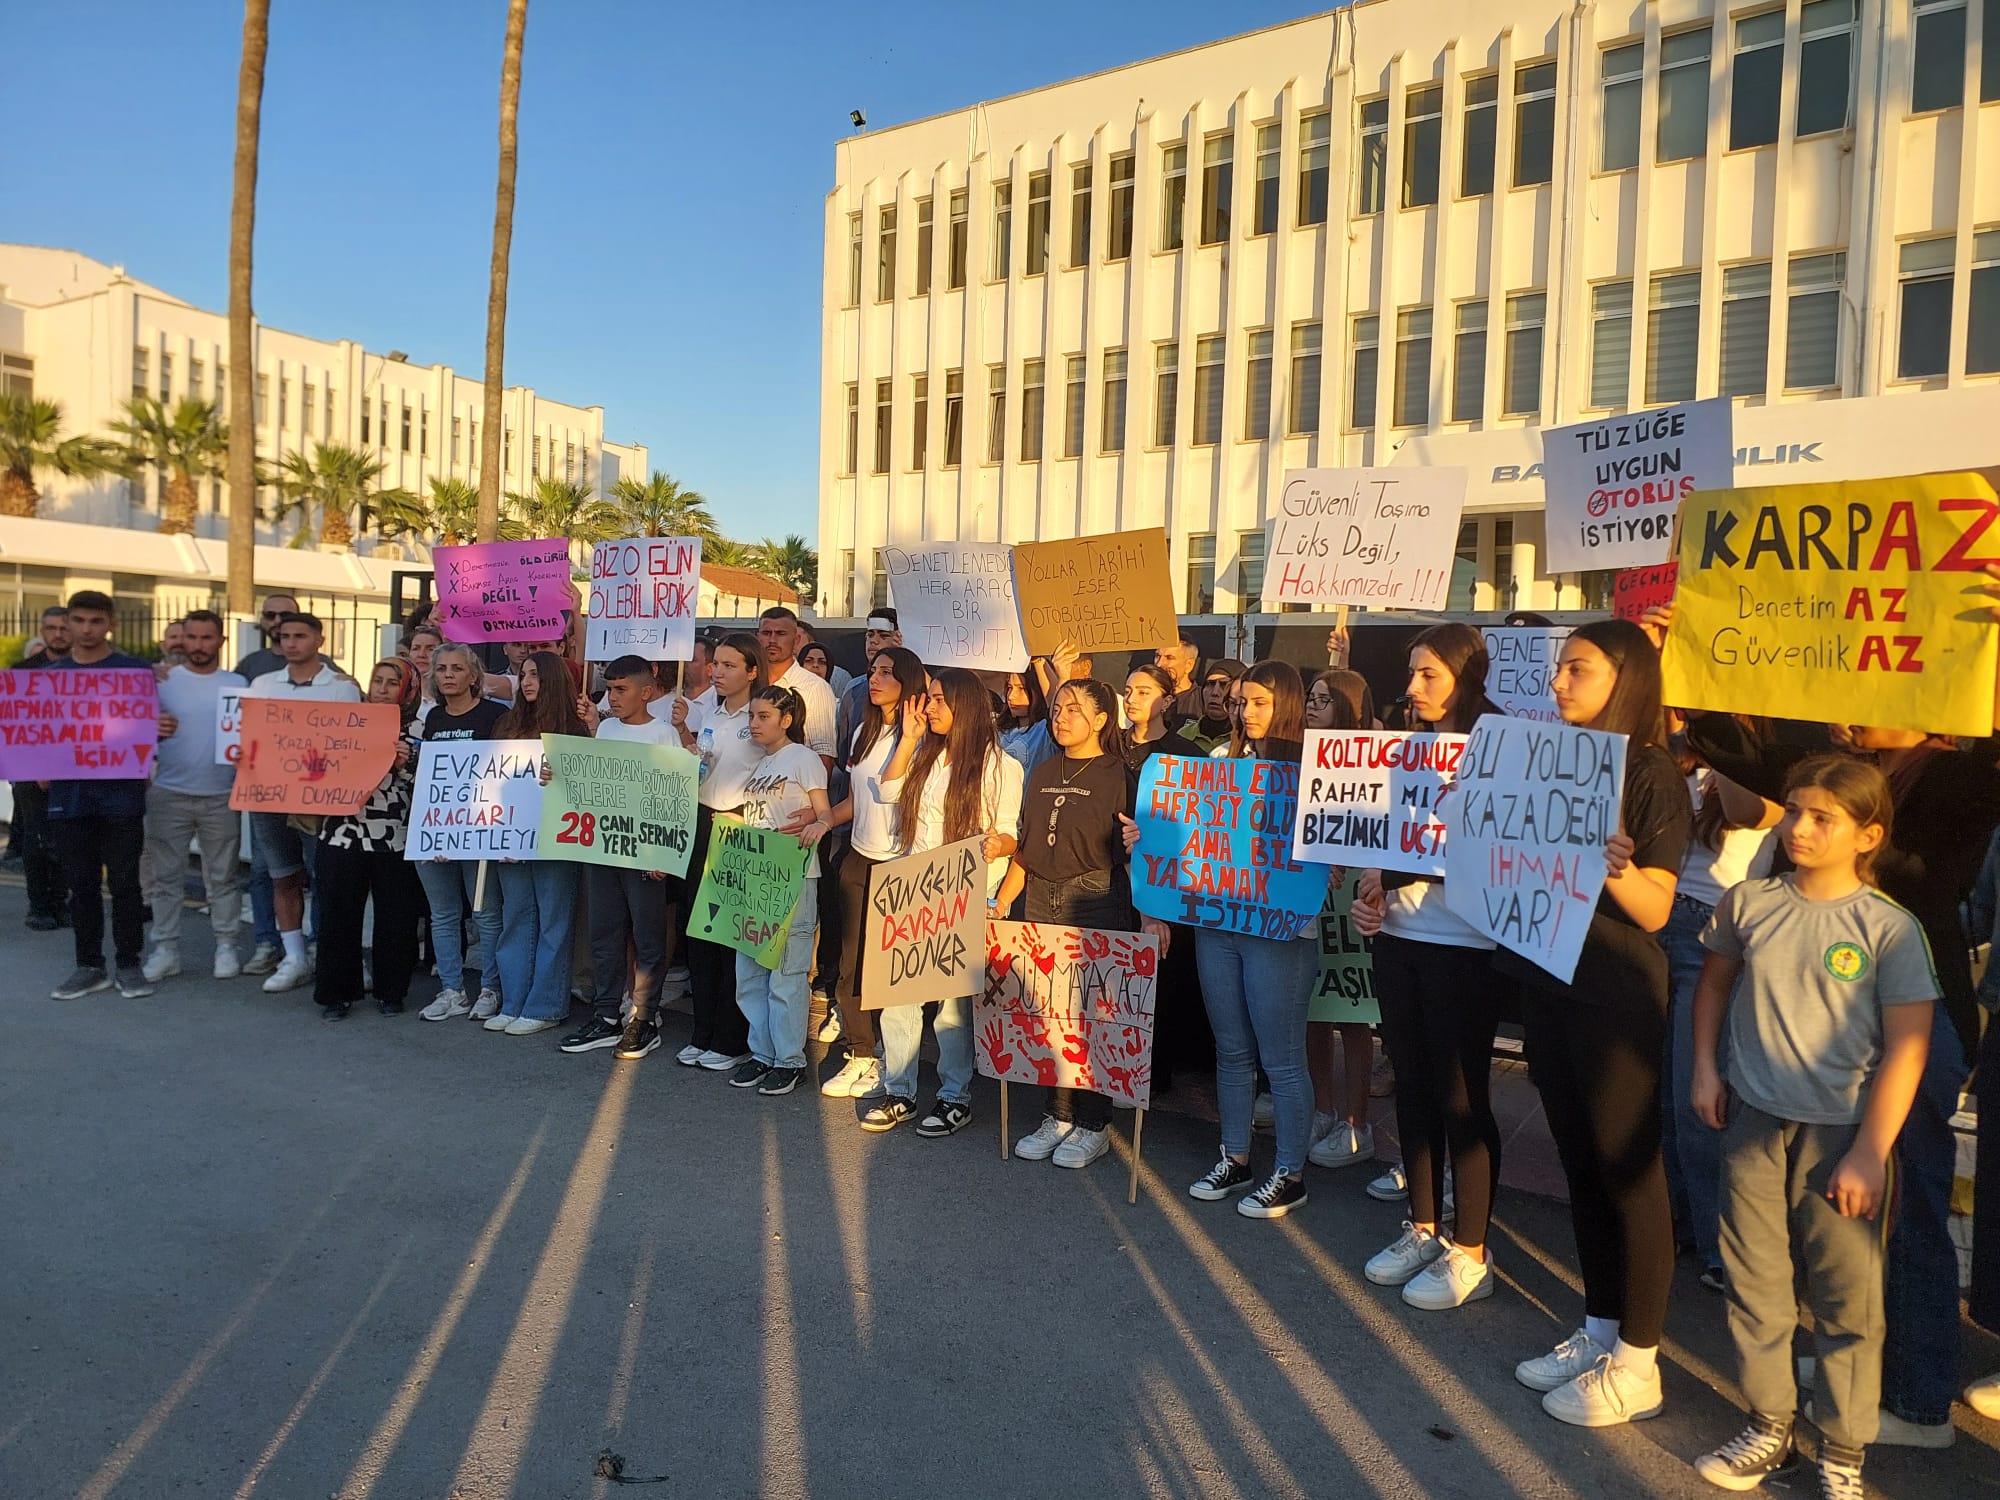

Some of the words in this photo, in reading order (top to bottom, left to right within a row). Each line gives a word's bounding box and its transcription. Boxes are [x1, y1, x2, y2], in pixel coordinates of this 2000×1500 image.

[1576, 410, 1686, 453] TÜZÜĞE
[1596, 448, 1681, 485] UYGUN
[1282, 480, 1360, 517] Güvenli
[1370, 480, 1430, 519] Taşıma
[1276, 521, 1329, 557] Lüks
[1342, 523, 1401, 565] Değil,
[1581, 514, 1677, 548] İSTİYOR
[1700, 500, 2000, 572] KARPAZ
[593, 543, 619, 579] BİZ
[623, 545, 640, 575] O
[649, 540, 693, 576] GÜN
[1022, 549, 1078, 583] YOLLAR
[1078, 541, 1146, 573] TARİHİ
[482, 585, 521, 604] DEĞİL
[920, 580, 951, 597] HER
[963, 578, 1013, 601] ARAÇ
[1073, 573, 1120, 596] ESER
[1279, 562, 1403, 598] Hakkımızdır
[588, 577, 695, 619] ÖLEBİLİRDİK
[952, 600, 982, 622] BİR
[1030, 597, 1131, 629] OTOBÜSLER
[1739, 585, 1835, 620] Denetim
[1845, 588, 1907, 622] AZ
[1066, 616, 1166, 648] MÜZELİK
[1485, 633, 1568, 665] DENET
[1711, 627, 1850, 672] Güvenlik
[1857, 635, 1923, 673] AZ
[560, 753, 643, 783] BOYUNDAN
[1461, 727, 1505, 780] BU
[1525, 732, 1615, 797] YOLDA
[429, 782, 489, 804] DEĞİL
[565, 778, 627, 809] İŞLERE
[642, 768, 692, 798] BÜYÜK
[1310, 778, 1383, 804] RAHAT
[640, 794, 690, 829] GİRMİŞ
[1463, 790, 1540, 846] KAZA
[1544, 788, 1609, 847] DEĞİL
[420, 828, 538, 852] DENETLEYİ
[556, 812, 596, 847] 28
[600, 815, 634, 834] CANI
[602, 833, 638, 858] YERE
[639, 821, 689, 859] SERMİŞ
[719, 825, 765, 855] YARALI
[1179, 829, 1231, 863] AMA
[1303, 808, 1389, 850] BİZİMKİ
[1401, 821, 1448, 860] UÇT
[1491, 842, 1589, 903] İHMAL
[882, 888, 970, 951] DEVRAN
